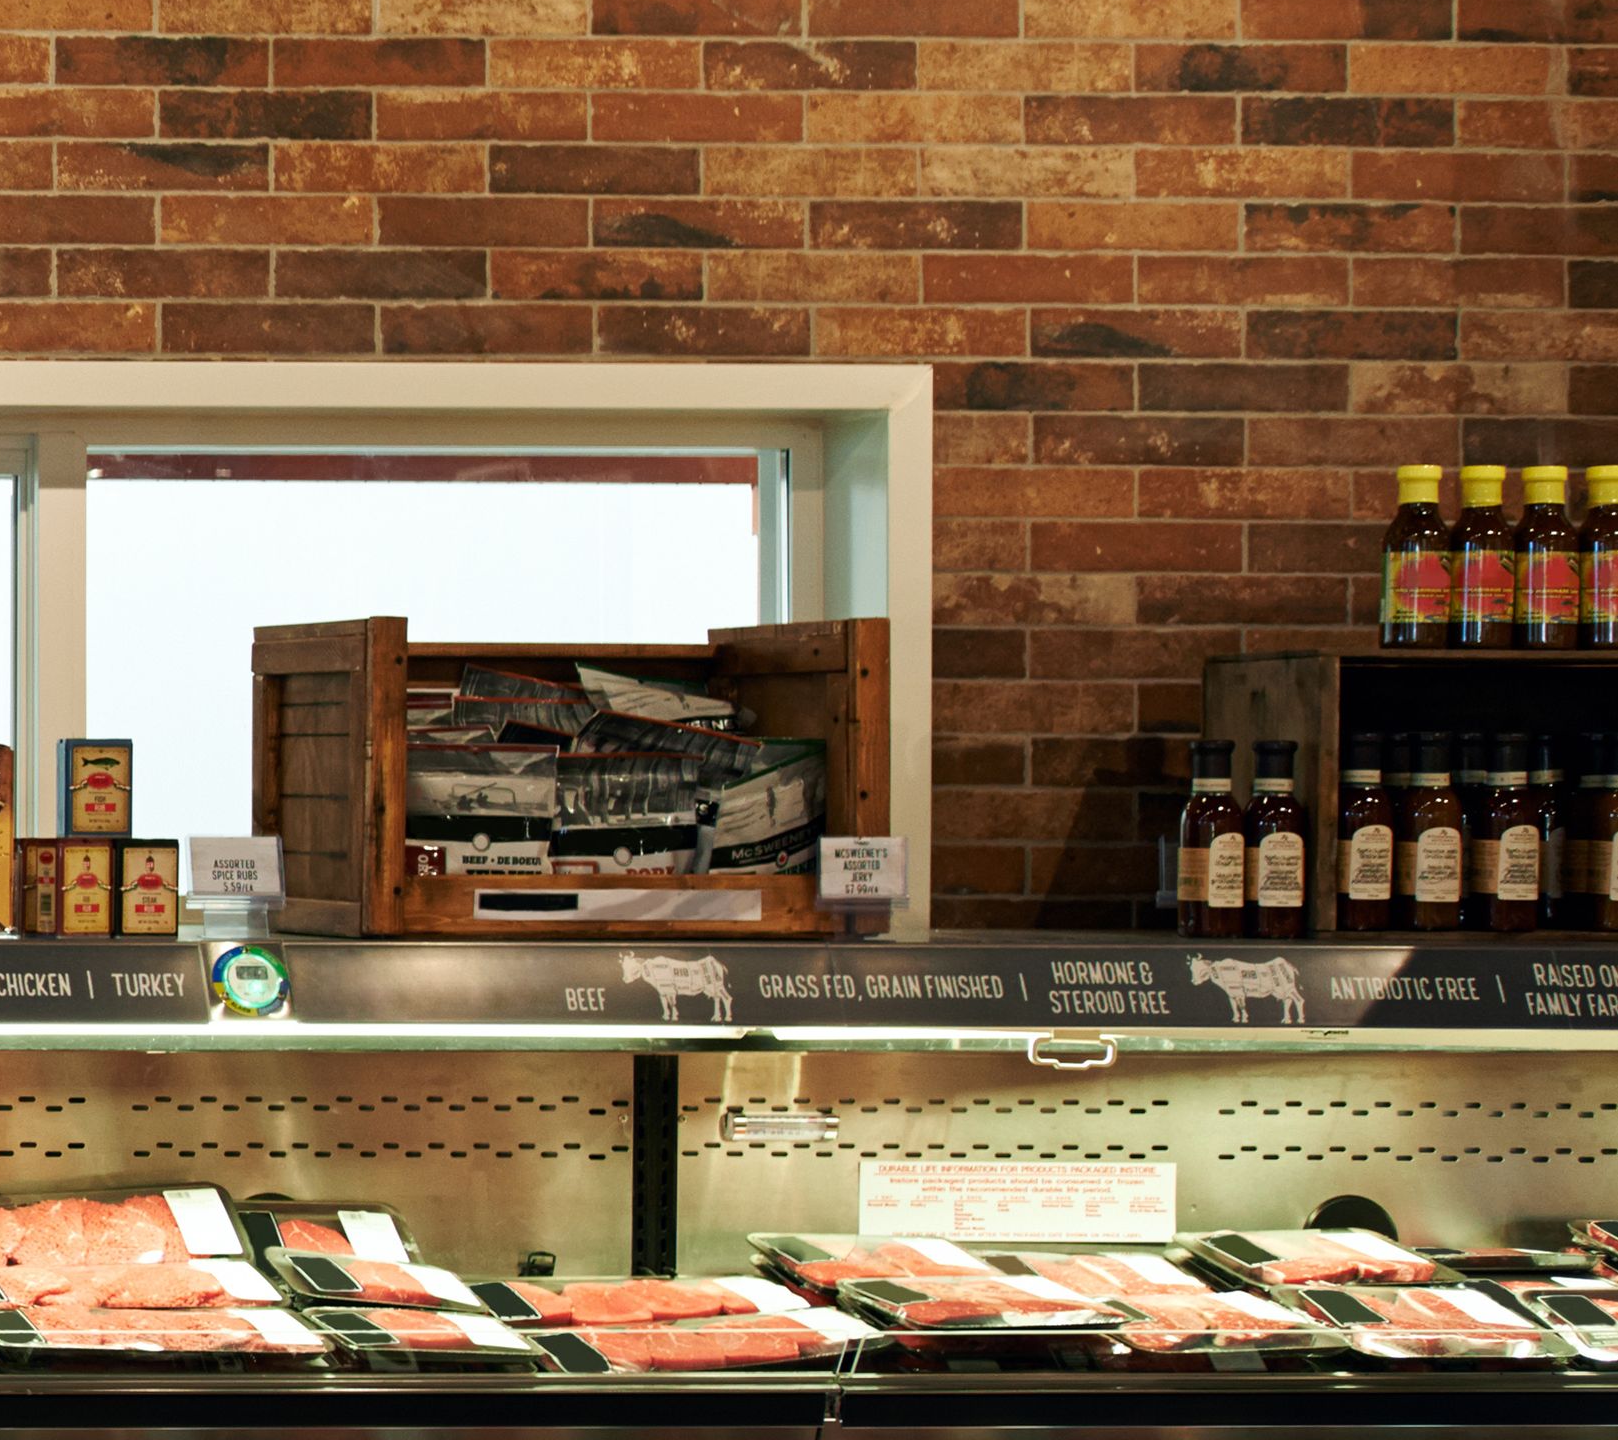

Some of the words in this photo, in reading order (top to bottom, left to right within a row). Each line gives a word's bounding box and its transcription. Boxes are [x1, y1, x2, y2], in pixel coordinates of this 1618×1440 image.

[213, 859, 255, 869] ASSORTED
[834, 848, 888, 858] MCSWEENEY'S
[843, 860, 880, 870] ASSORTED
[212, 870, 234, 880] SPICE
[236, 870, 258, 880] RUBS
[850, 872, 873, 882] JERKY
[112, 973, 185, 997] TURKEY
[1051, 961, 1139, 985] HORMONE
[1140, 962, 1153, 986] &
[1534, 963, 1595, 987] RAISED
[565, 987, 606, 1012] BEEF
[759, 974, 819, 1000] GRASS
[823, 974, 863, 1002] FED,
[866, 974, 921, 1000] GRAIN
[926, 975, 1004, 1000] FINISHED
[1330, 975, 1433, 1000] ANTIBIOTIC
[1438, 975, 1480, 1001] FREE
[1050, 989, 1125, 1014] STEROID
[1130, 990, 1170, 1015] FREE
[1525, 992, 1584, 1017] FAMILY
